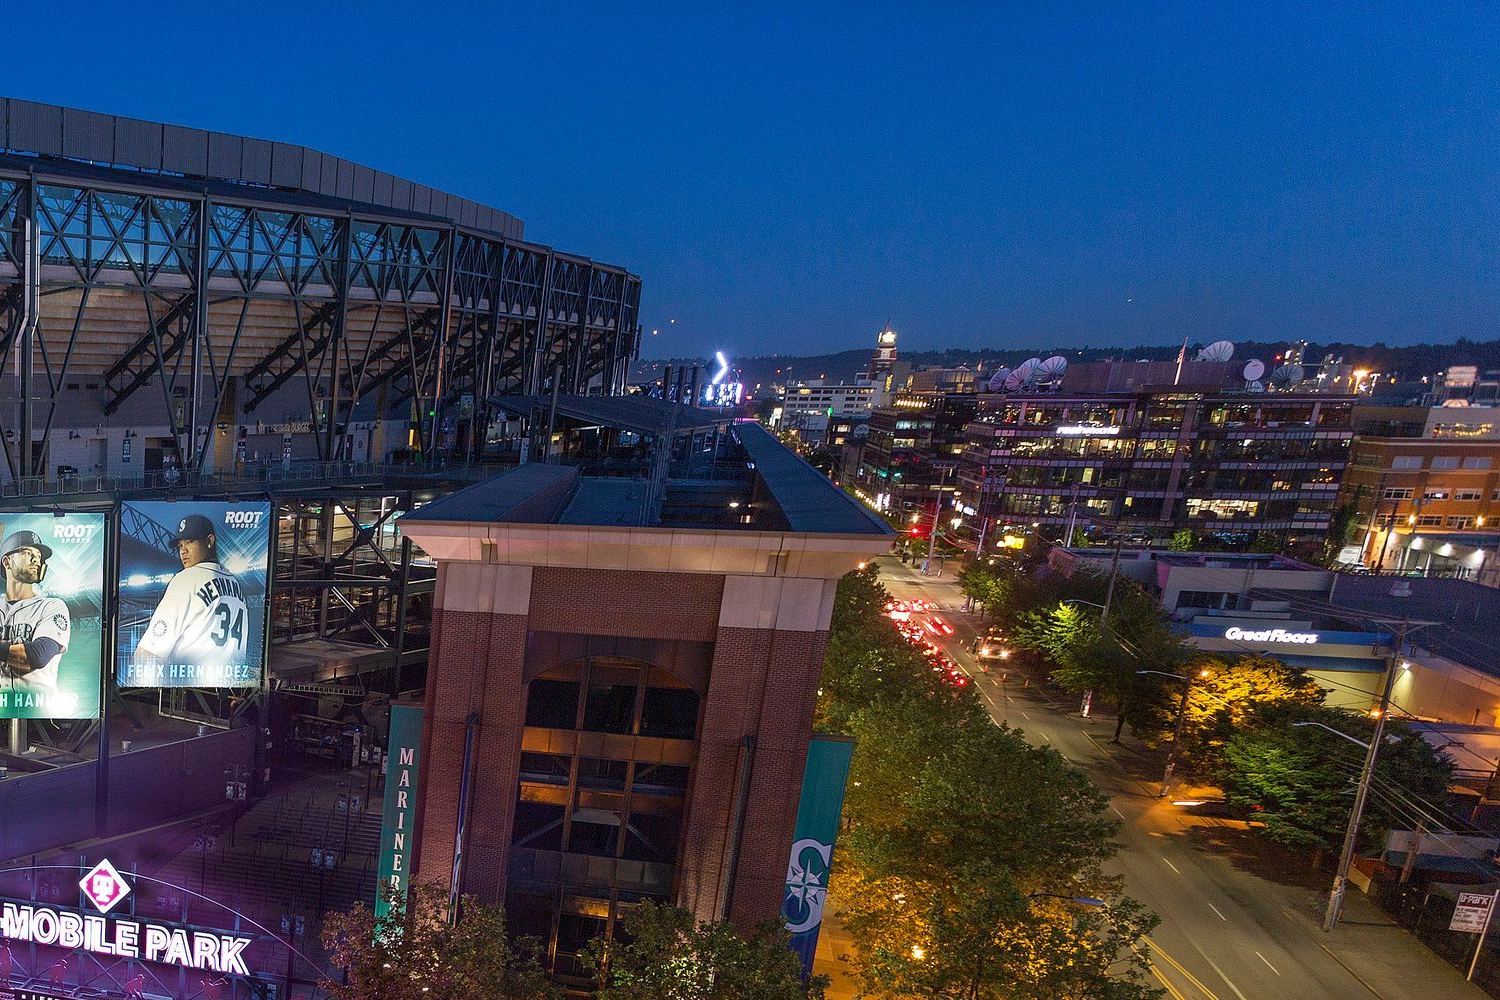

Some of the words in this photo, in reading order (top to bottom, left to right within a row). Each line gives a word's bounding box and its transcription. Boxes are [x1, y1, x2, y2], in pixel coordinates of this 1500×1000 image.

[53, 524, 96, 538] ROOT
[225, 511, 263, 524] ROOT
[211, 602, 244, 650] 34
[145, 924, 252, 976] PARK
